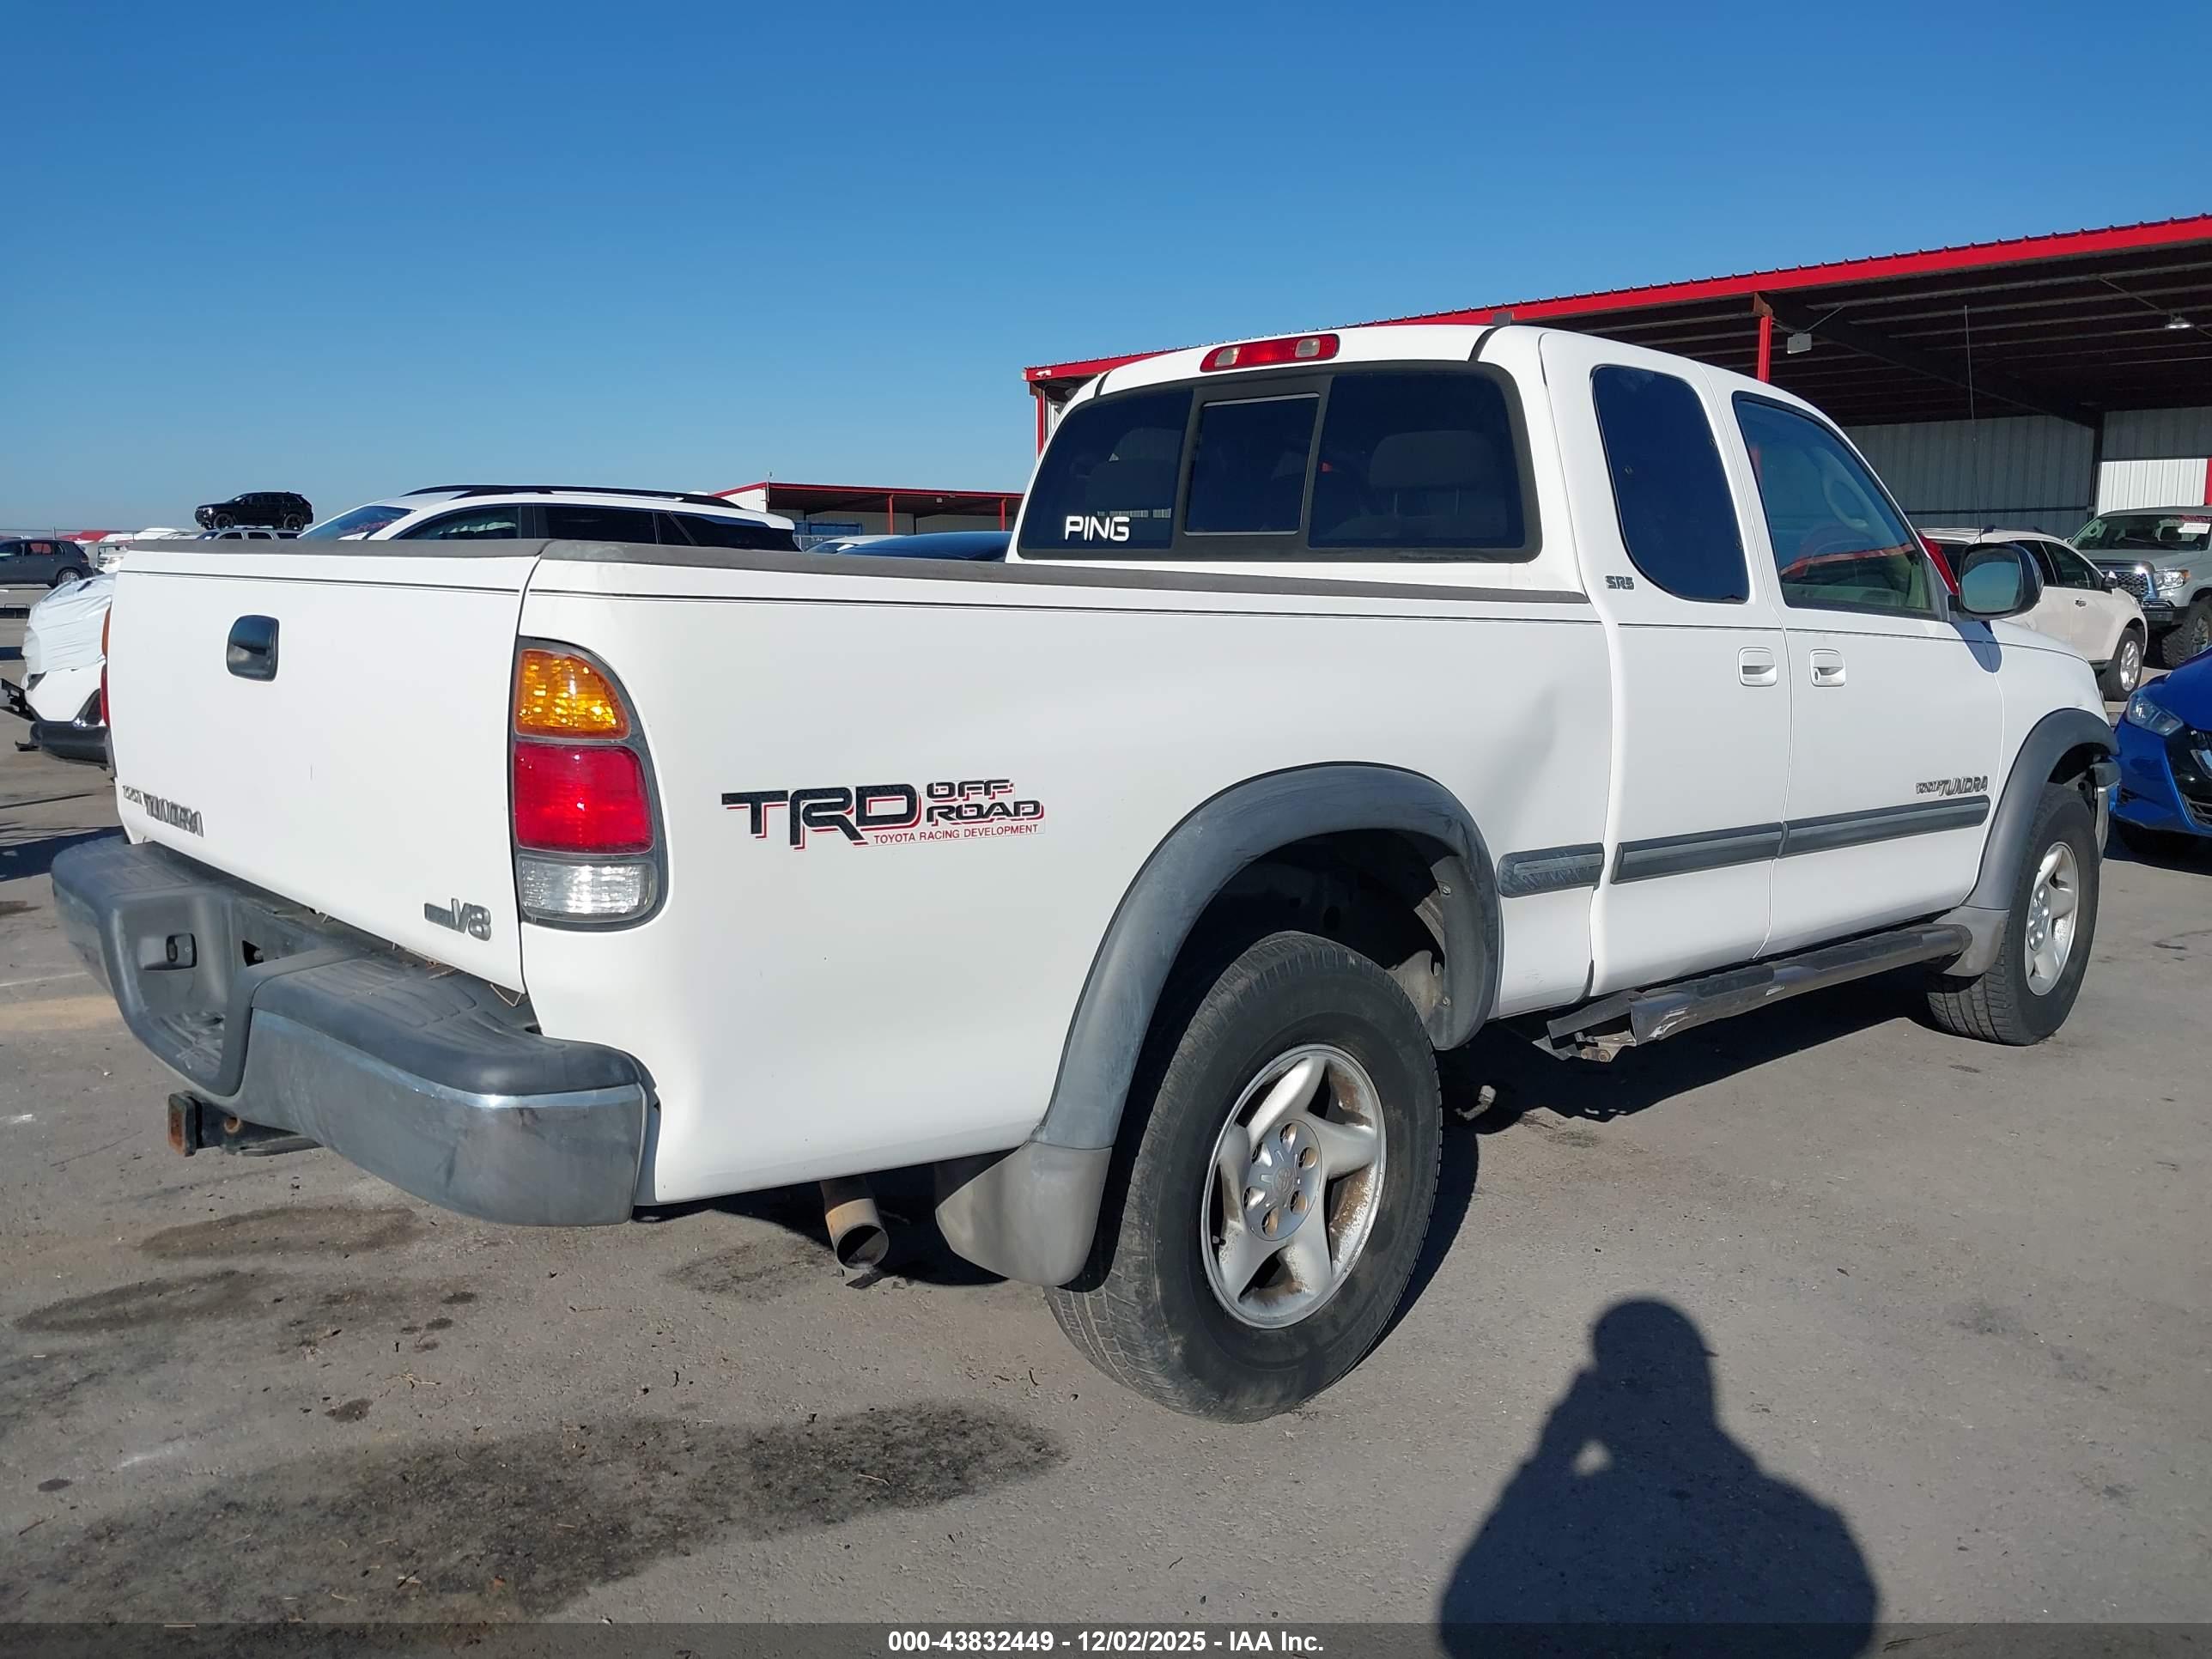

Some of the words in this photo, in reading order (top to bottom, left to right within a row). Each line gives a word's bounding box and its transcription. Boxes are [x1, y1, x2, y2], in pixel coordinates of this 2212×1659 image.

[1065, 515, 1130, 542] PING
[1605, 575, 1635, 590] SR5
[927, 779, 1014, 802] OFF
[1937, 775, 1988, 796] TUNDRA
[143, 792, 204, 837] TUNDRA
[721, 783, 921, 851] TRD
[927, 799, 1045, 825] ROAD
[874, 833, 916, 845] TOYOTA
[919, 830, 960, 842] RACING
[963, 823, 1039, 838] DEVELOPMENT
[451, 897, 492, 942] V8
